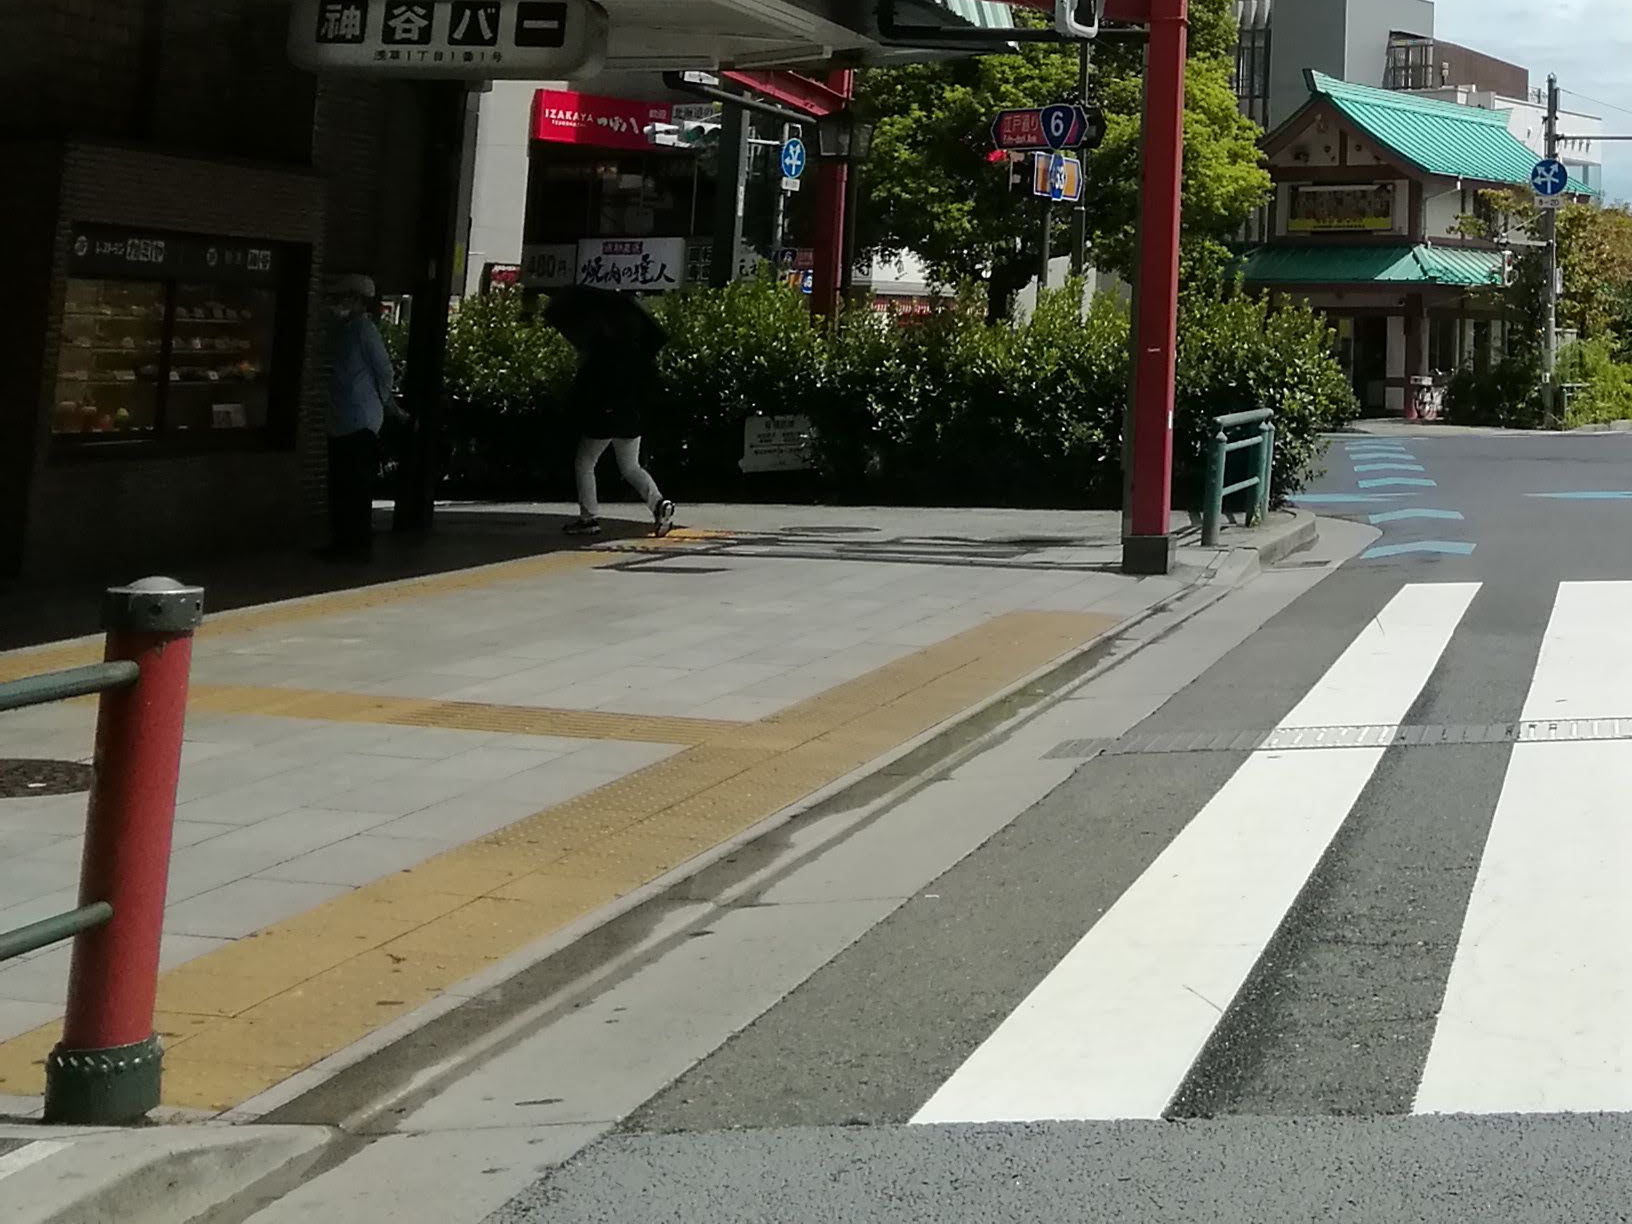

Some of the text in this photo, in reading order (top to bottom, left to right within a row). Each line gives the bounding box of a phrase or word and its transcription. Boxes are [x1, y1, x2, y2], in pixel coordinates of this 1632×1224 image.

[319, 3, 557, 42] 神谷バー
[544, 108, 594, 124] IZAKAYA
[1050, 110, 1065, 137] 6
